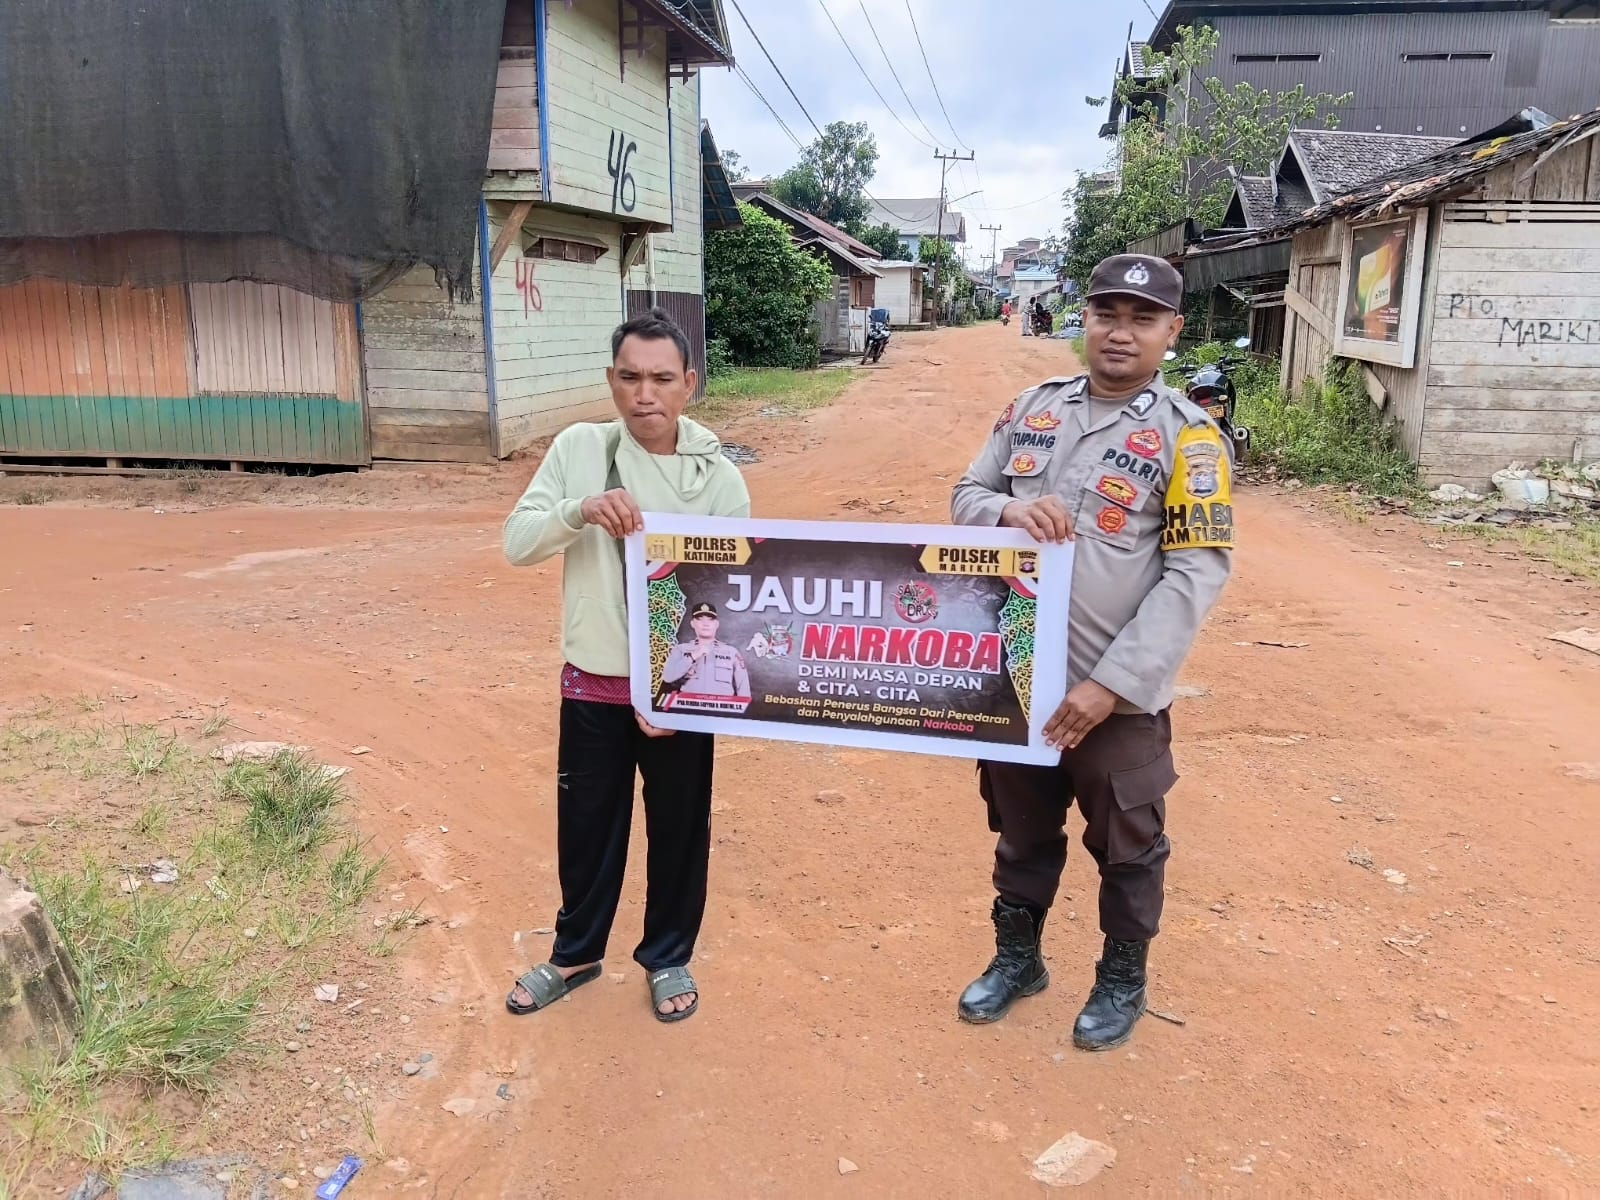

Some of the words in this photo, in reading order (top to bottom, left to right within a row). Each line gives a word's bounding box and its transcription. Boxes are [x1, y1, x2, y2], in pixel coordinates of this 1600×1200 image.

[607, 129, 637, 213] 46
[515, 257, 543, 319] 46
[1012, 432, 1056, 449] TUPANG
[1102, 448, 1159, 482] POLRI
[683, 536, 737, 551] POLRES
[683, 551, 737, 562] KATINGAN
[938, 547, 1000, 564] POLSEK
[939, 563, 999, 573] MARIKIT
[724, 574, 883, 618] JAUHI
[801, 622, 1002, 676] NARKOBA
[798, 664, 846, 680] DEMI
[853, 668, 909, 685] MASA
[914, 671, 983, 691] DEPAN
[797, 680, 810, 693] &
[816, 682, 860, 697] CITA
[876, 686, 920, 703] CITA
[764, 694, 820, 707] Bebaskan
[823, 698, 870, 711] Penerus
[872, 703, 917, 716] Bangsa
[919, 707, 945, 719] Dari
[947, 710, 1010, 725] Peredaran
[797, 707, 820, 718] dan
[822, 709, 920, 727] Penyalahgunaan
[923, 719, 975, 733] Narkoba
